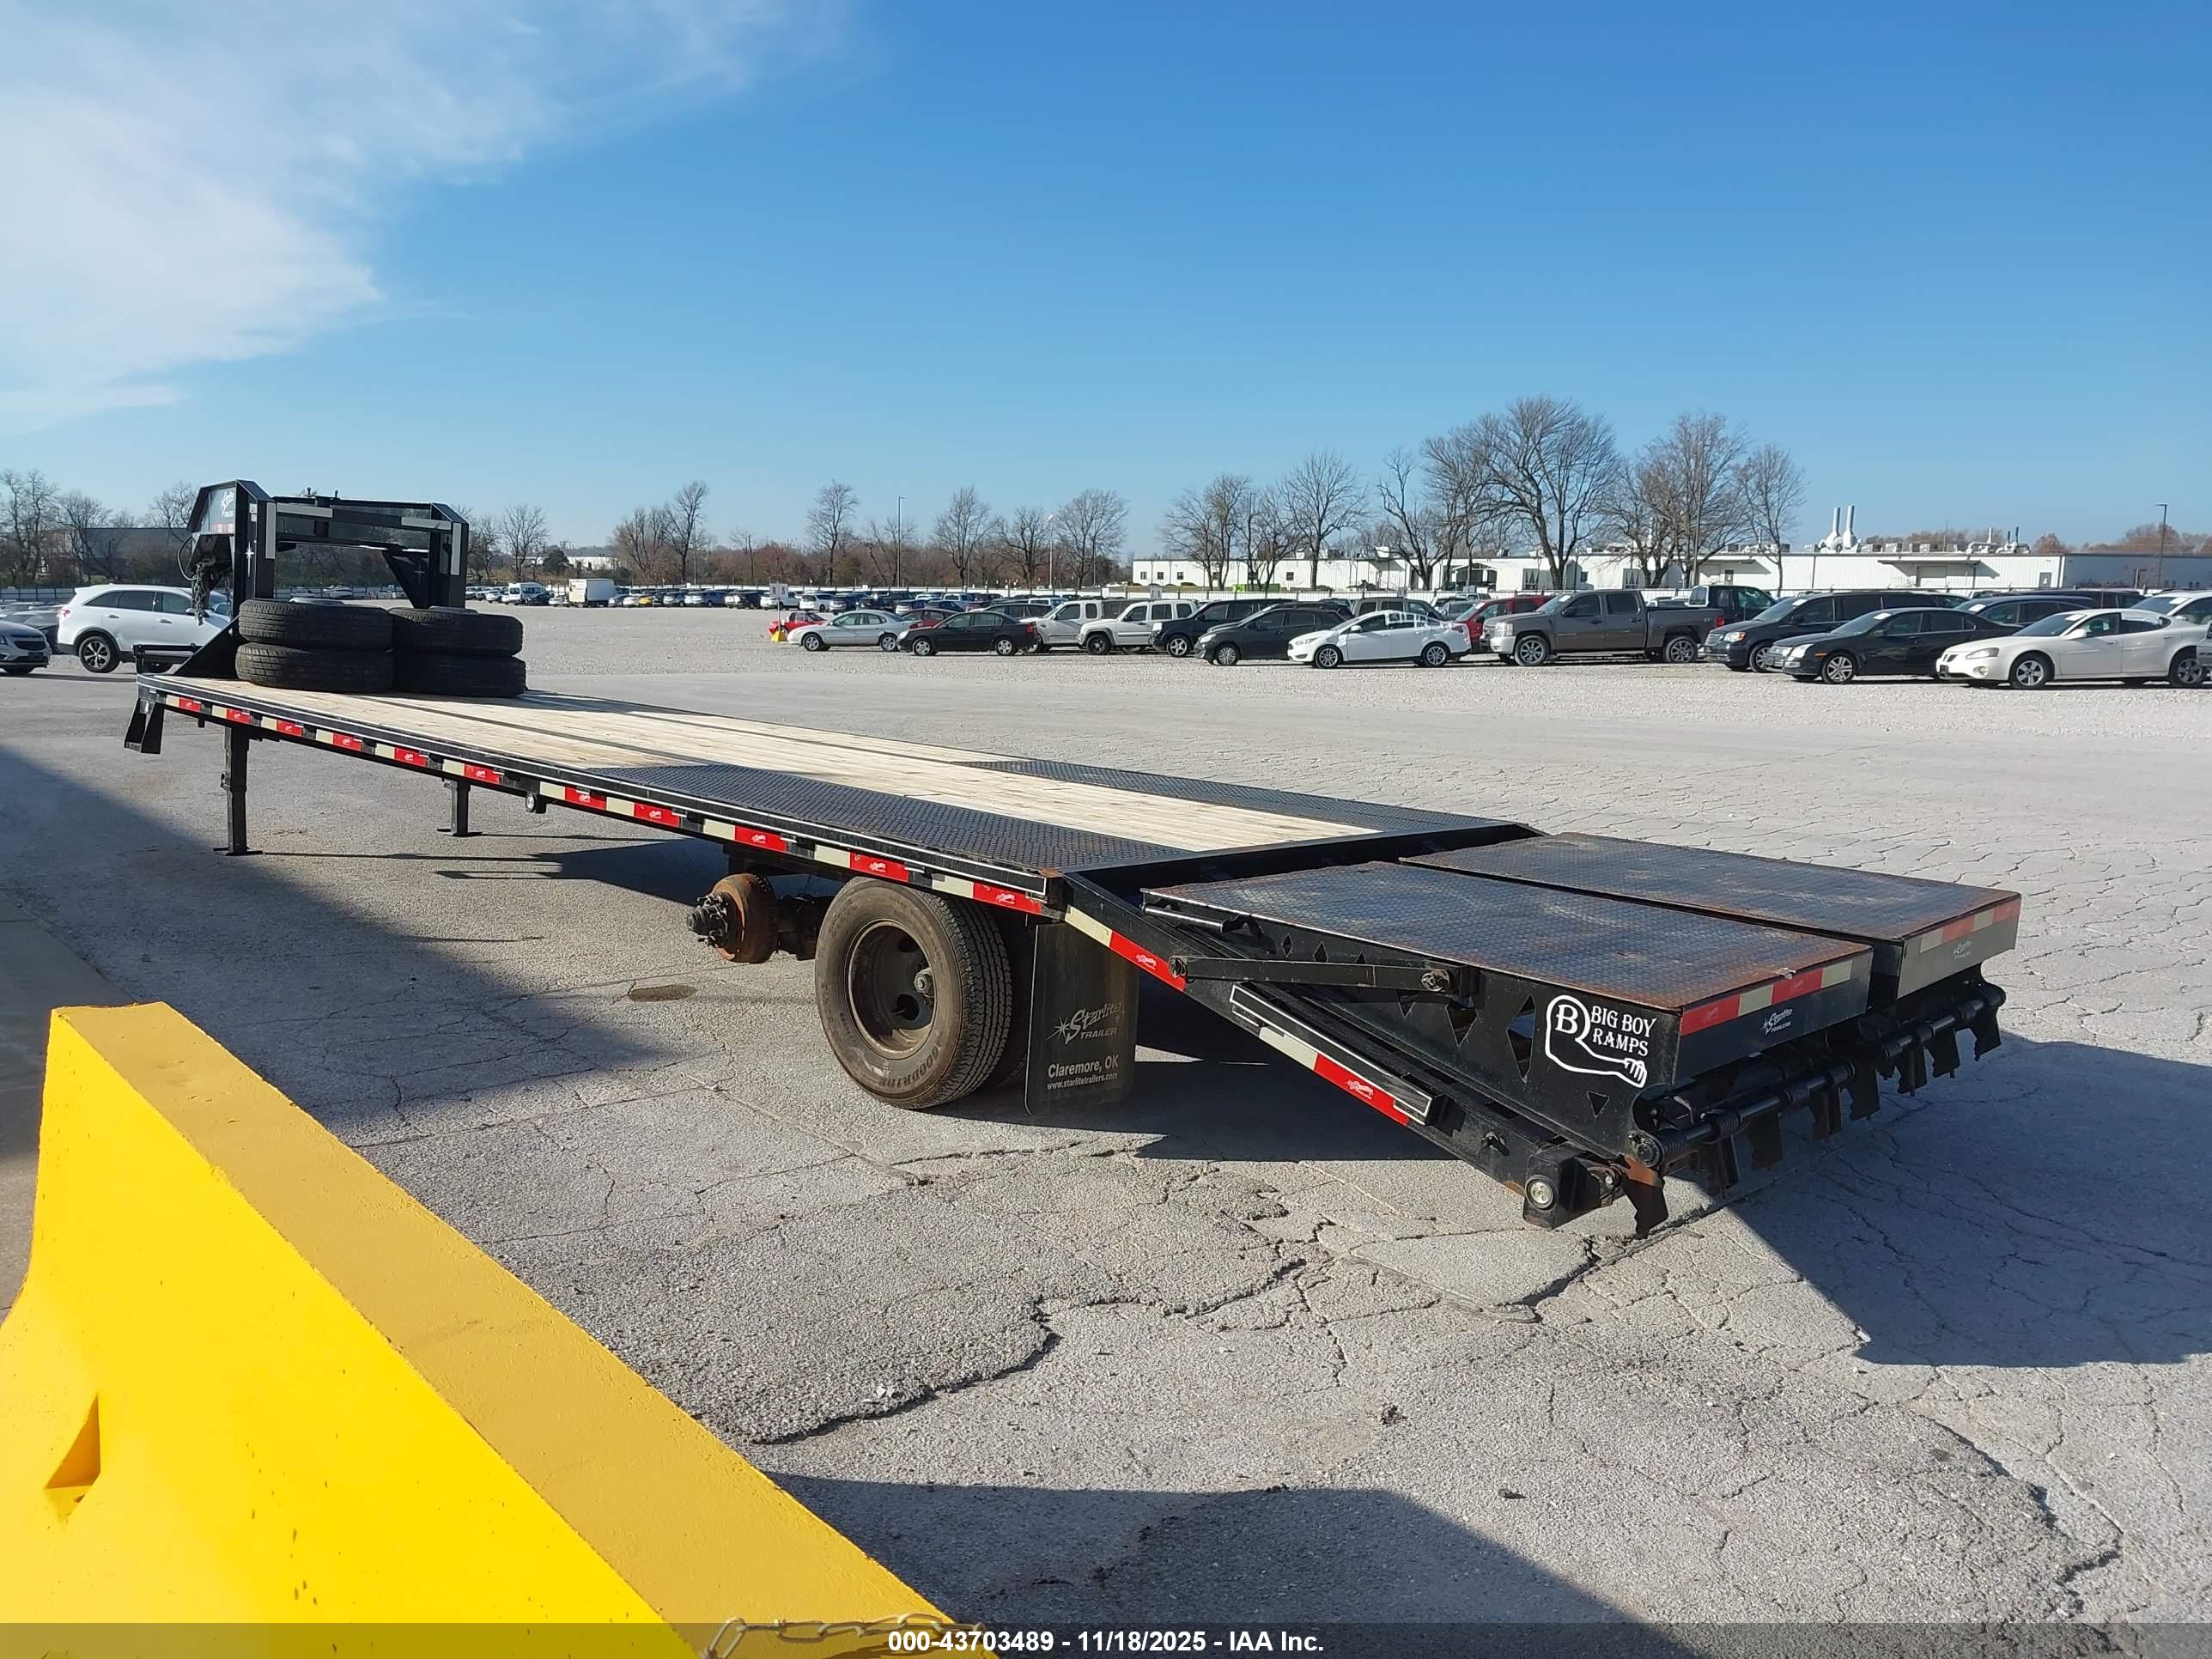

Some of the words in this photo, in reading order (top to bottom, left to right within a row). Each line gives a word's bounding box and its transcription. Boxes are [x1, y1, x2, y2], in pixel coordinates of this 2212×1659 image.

[1065, 1002, 1121, 1045] Starlite
[1590, 1006, 1619, 1029] BIG
[1621, 1013, 1657, 1038] BOY
[1592, 1028, 1650, 1057] RAMPS
[1048, 1060, 1103, 1078] Claremore,
[1105, 1054, 1120, 1069] OK
